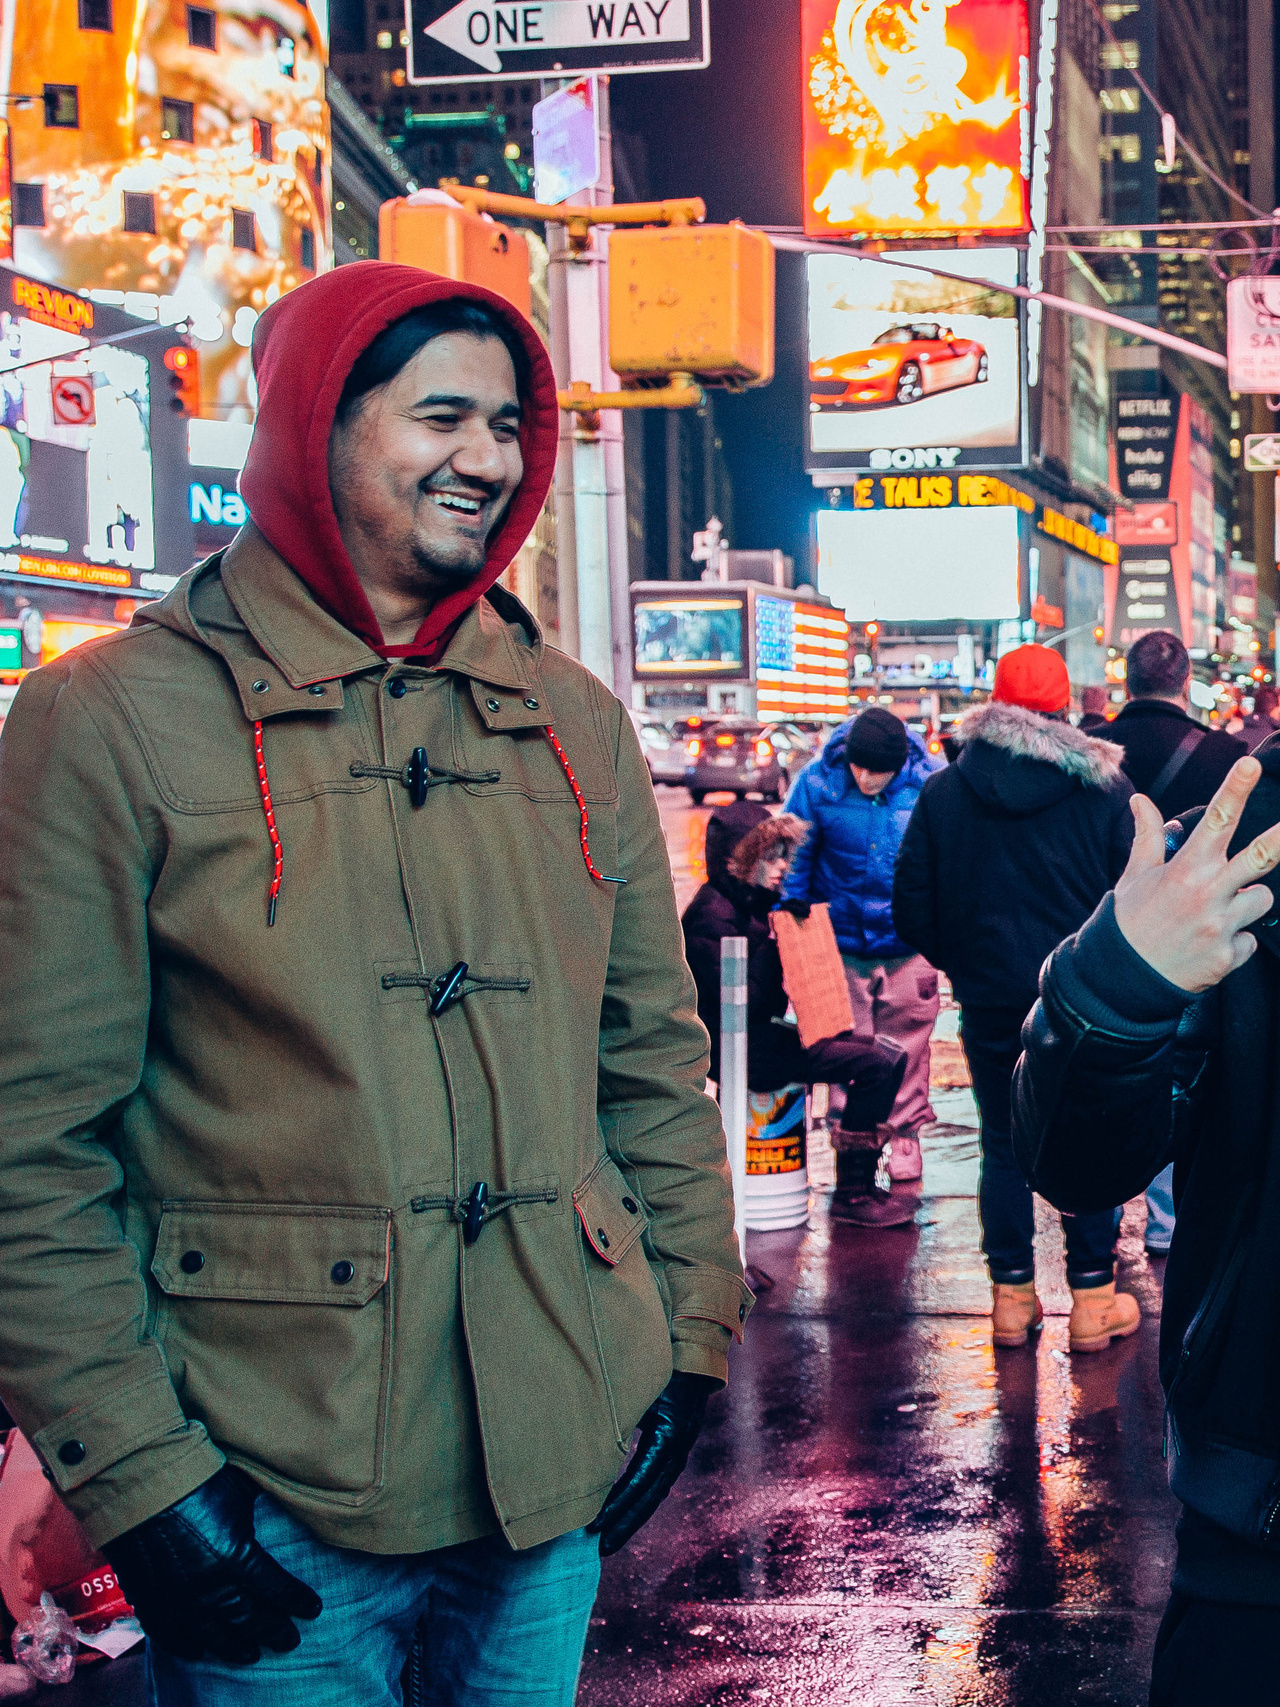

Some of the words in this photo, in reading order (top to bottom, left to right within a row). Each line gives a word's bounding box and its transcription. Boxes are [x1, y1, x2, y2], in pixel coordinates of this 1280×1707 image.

[468, 8, 544, 46] ONE
[587, 0, 670, 39] WAY
[12, 276, 94, 329] REVLON
[869, 447, 962, 470] SONY
[881, 476, 953, 508] TALKS
